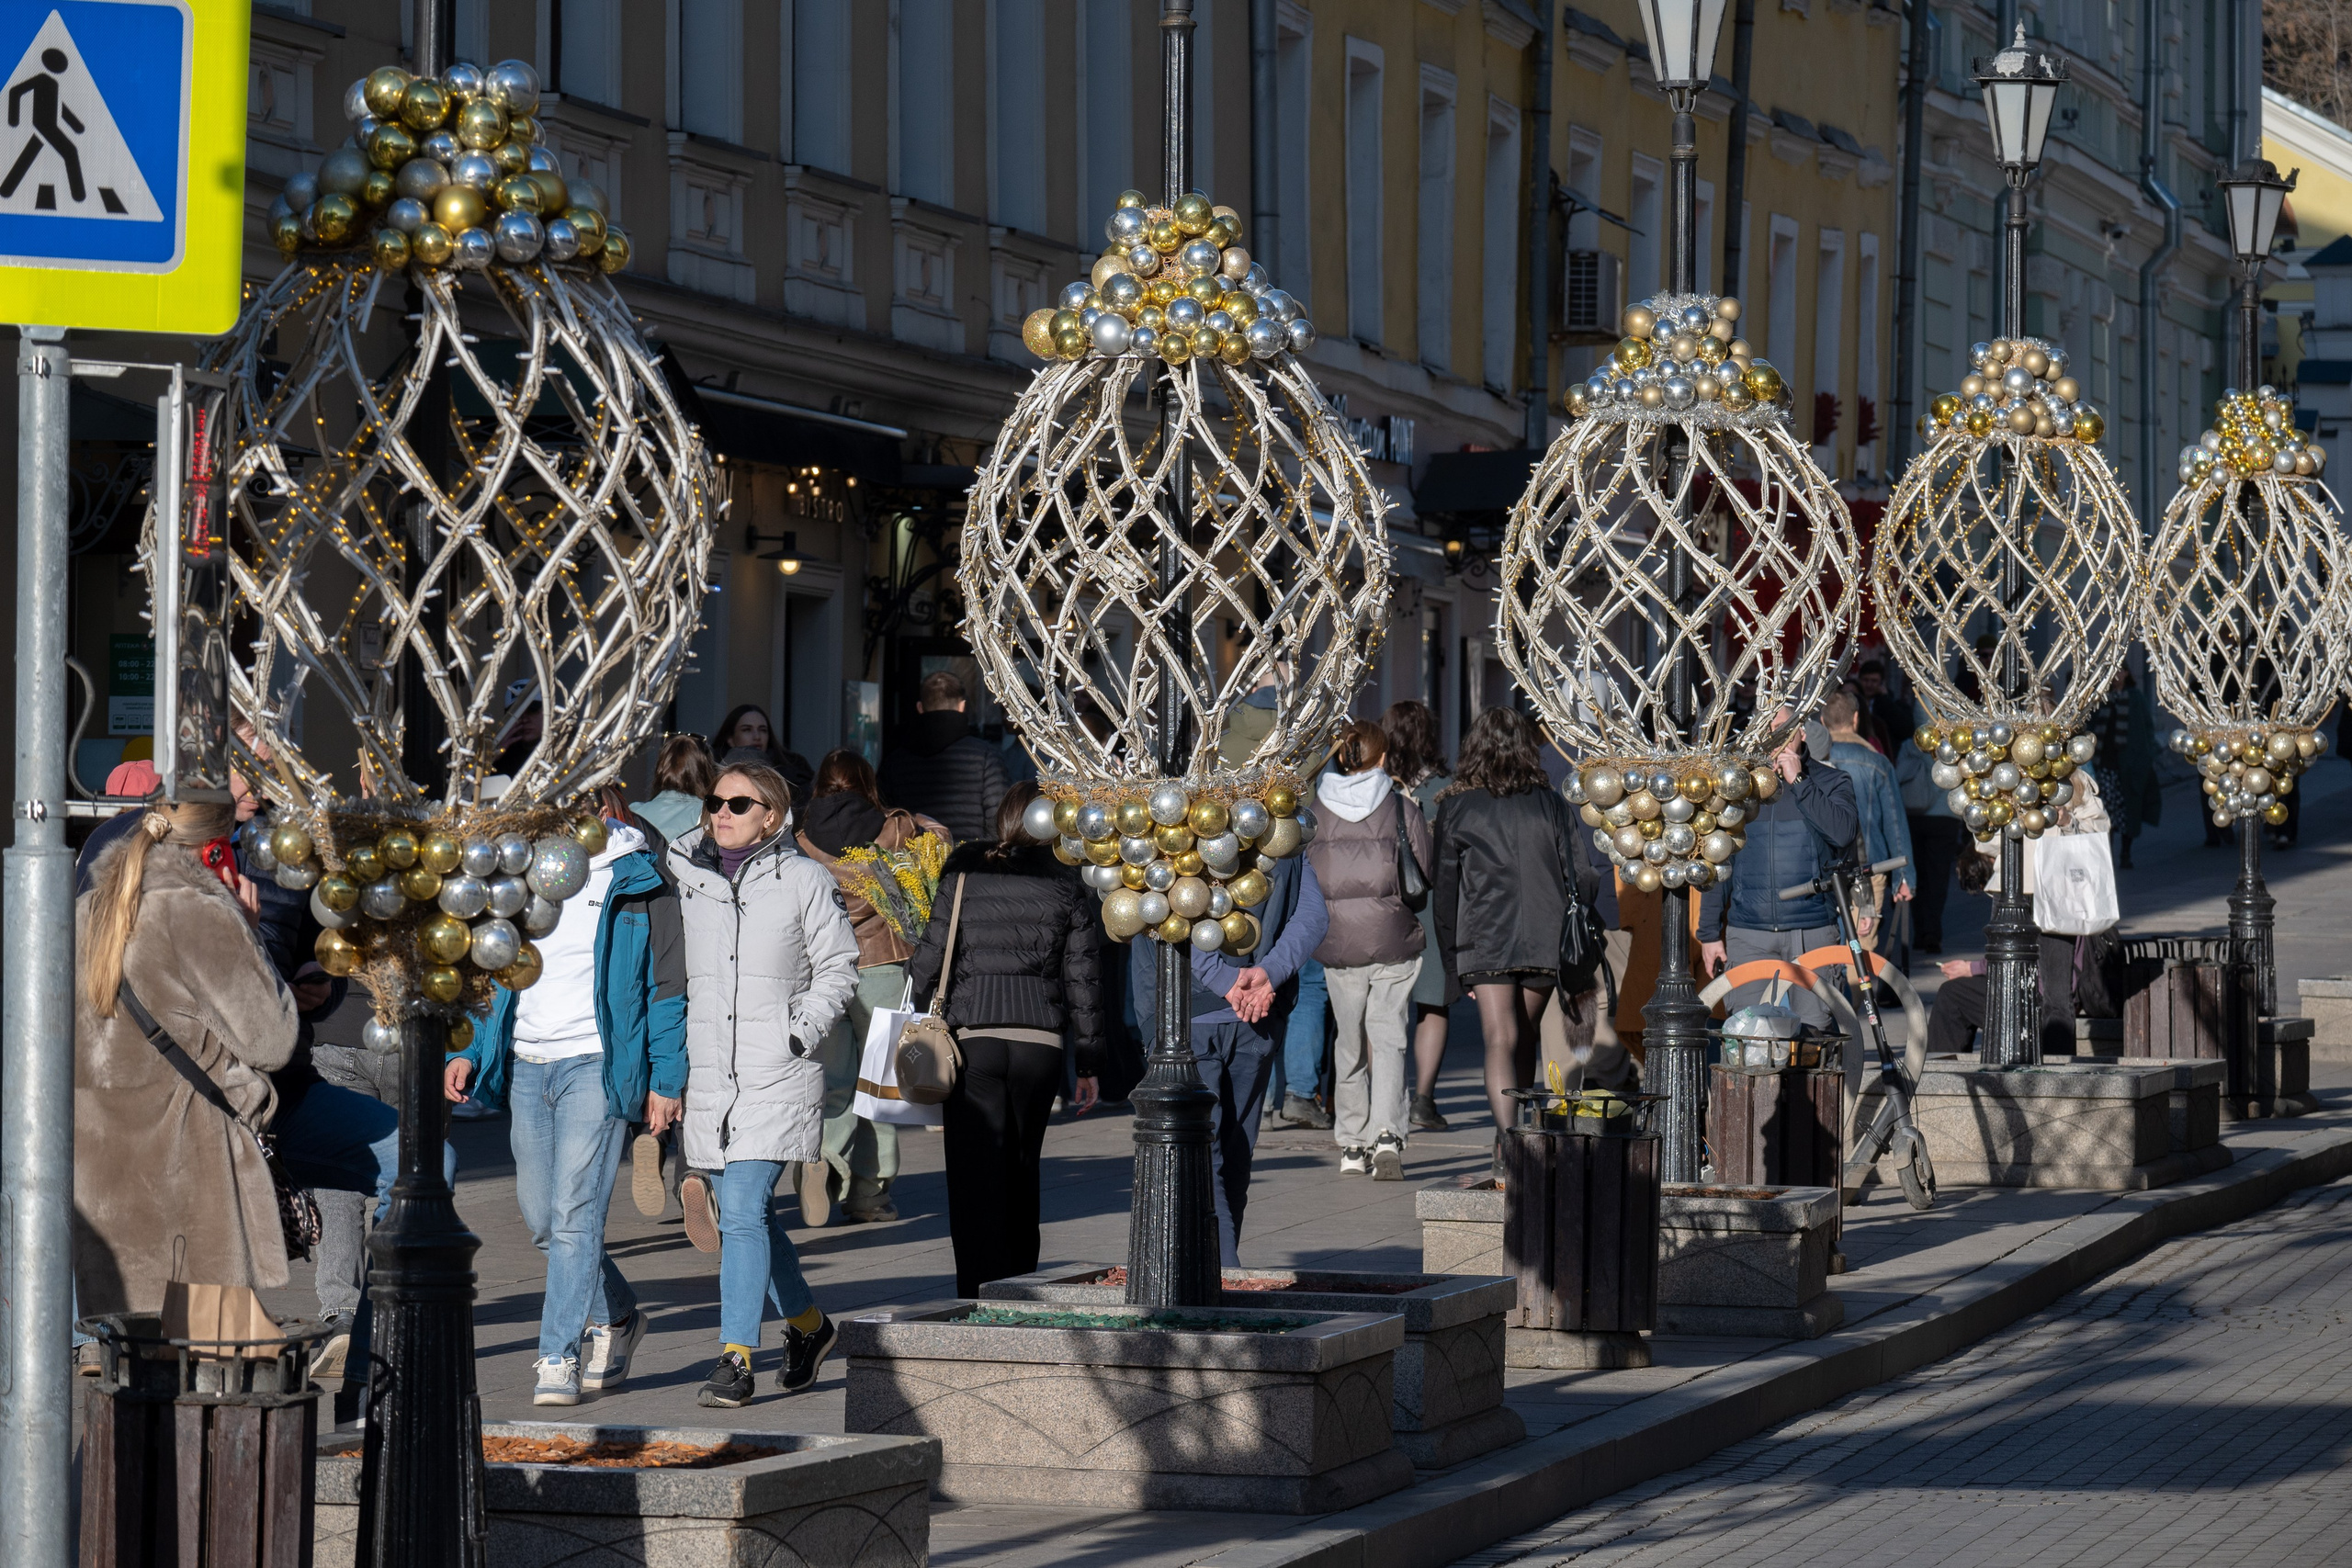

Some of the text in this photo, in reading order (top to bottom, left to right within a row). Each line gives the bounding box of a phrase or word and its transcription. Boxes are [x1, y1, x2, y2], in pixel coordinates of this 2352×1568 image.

[799, 493, 843, 523] BISTRO
[118, 660, 140, 668] 08:00
[118, 672, 140, 681] 10:00
